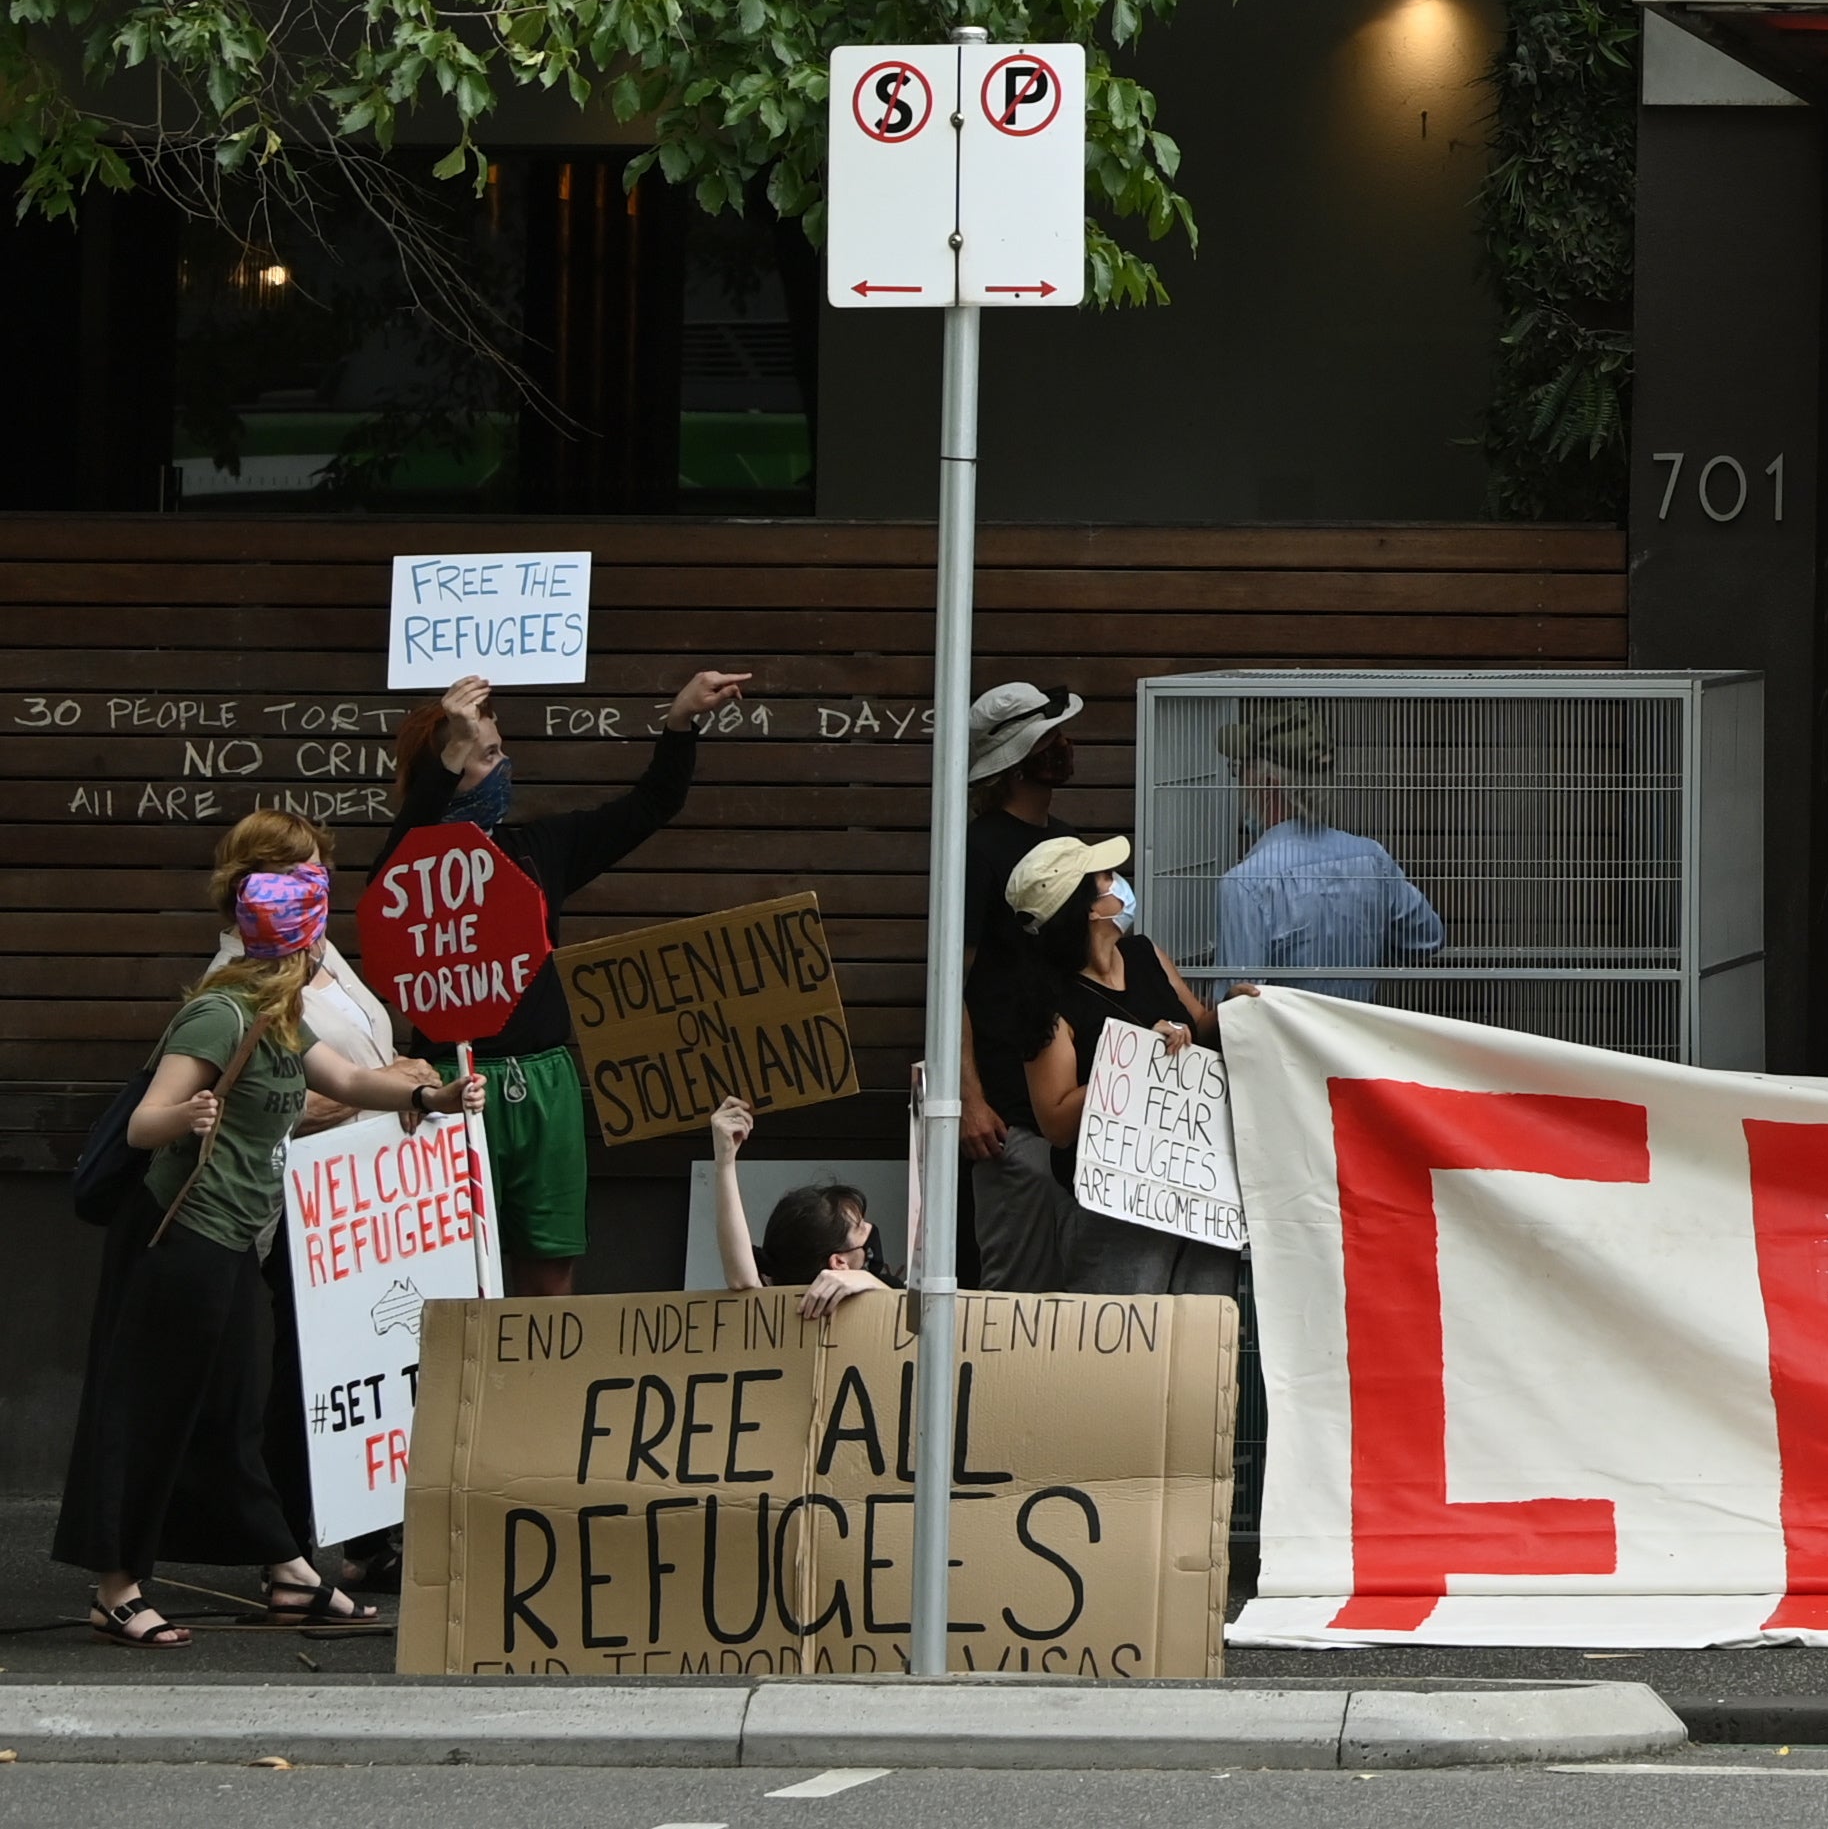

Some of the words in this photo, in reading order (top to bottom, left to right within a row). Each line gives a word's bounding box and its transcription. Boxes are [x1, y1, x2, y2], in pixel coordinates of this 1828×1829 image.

[1653, 452, 1783, 522] 701
[411, 560, 503, 604] FREE
[516, 561, 578, 598] THE
[405, 613, 583, 664] REFUGEES
[14, 698, 81, 725] 30
[107, 698, 238, 730] PEOPLE
[263, 702, 410, 731] TORT
[545, 705, 628, 737] FOR
[183, 740, 262, 777] NO
[138, 783, 222, 820] ARE
[255, 789, 395, 821] UNDER
[382, 847, 494, 919] STOP
[408, 914, 479, 957] THE
[571, 927, 727, 1027] STOLEN
[720, 907, 830, 996] LIVES
[393, 953, 530, 1013] TORTURE
[676, 1001, 731, 1047] ON
[1099, 1024, 1138, 1069] NO
[594, 1045, 741, 1137] STOLEN
[731, 1015, 851, 1109] LAND
[1090, 1068, 1131, 1115] NO
[1144, 1086, 1213, 1145] FEAR
[292, 1122, 470, 1230] WELCOME
[1085, 1114, 1217, 1192] REFUGEES
[1079, 1166, 1113, 1208] ARE
[1123, 1178, 1199, 1235] WELCOME
[305, 1186, 474, 1288] REFUGEES
[498, 1312, 583, 1363] END
[893, 1293, 1158, 1354] DTENTION
[309, 1373, 386, 1435] #SET
[577, 1369, 783, 1485] FREE
[816, 1360, 1014, 1485] ALL
